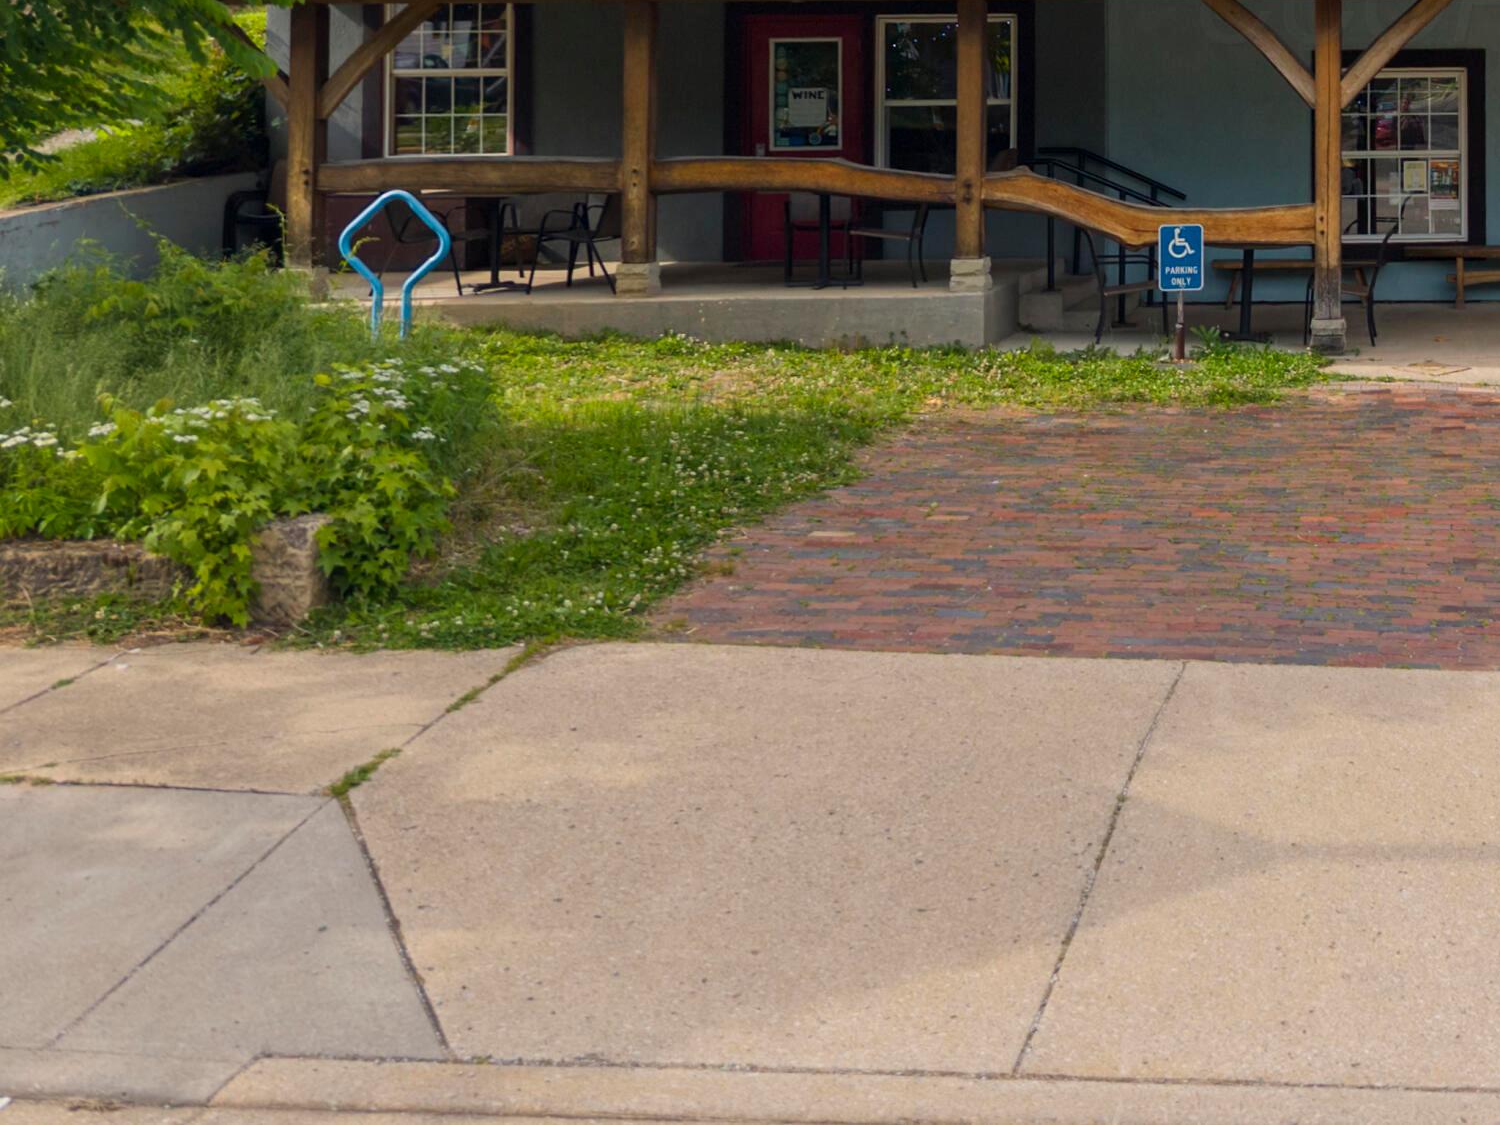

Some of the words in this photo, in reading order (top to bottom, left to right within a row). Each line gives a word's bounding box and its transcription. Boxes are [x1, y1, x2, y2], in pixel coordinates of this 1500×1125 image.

[792, 90, 825, 100] WINE
[1165, 266, 1198, 275] PARKING
[1171, 277, 1191, 286] ONLY
